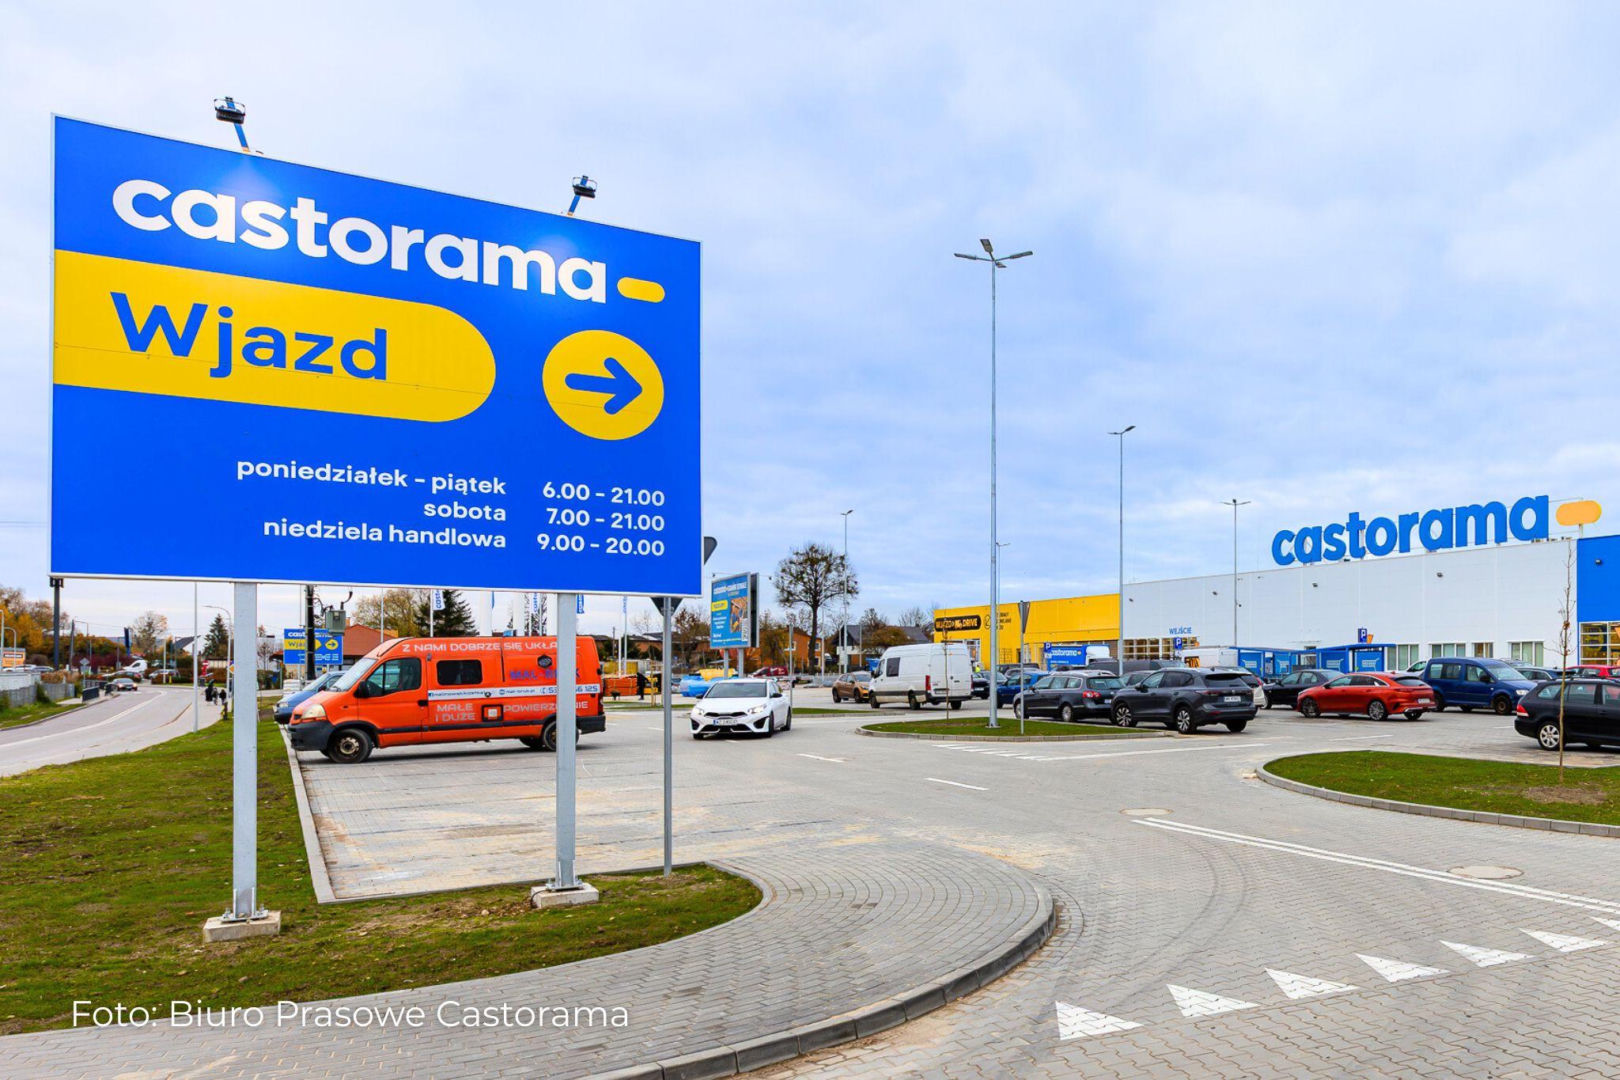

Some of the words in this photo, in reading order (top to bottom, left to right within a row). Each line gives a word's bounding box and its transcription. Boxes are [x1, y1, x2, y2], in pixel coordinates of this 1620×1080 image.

[113, 179, 606, 303] castorama
[111, 293, 388, 380] Wjazd
[237, 461, 408, 487] poniedziałek
[431, 474, 506, 495] piątek
[542, 482, 590, 501] 6.00
[611, 488, 665, 506] 21.00
[263, 518, 383, 541] niedziela
[389, 523, 506, 548] handlowa
[537, 534, 585, 551] 9.00
[606, 538, 665, 556] 20.00
[423, 502, 506, 521] sobota
[546, 508, 590, 526] 7.00
[611, 513, 665, 531] 21.00
[1271, 495, 1549, 566] castorama
[414, 643, 447, 652] NAMI
[449, 642, 501, 652] DOBRZE
[503, 641, 523, 652] SIĘ
[436, 702, 473, 712] MAŁE
